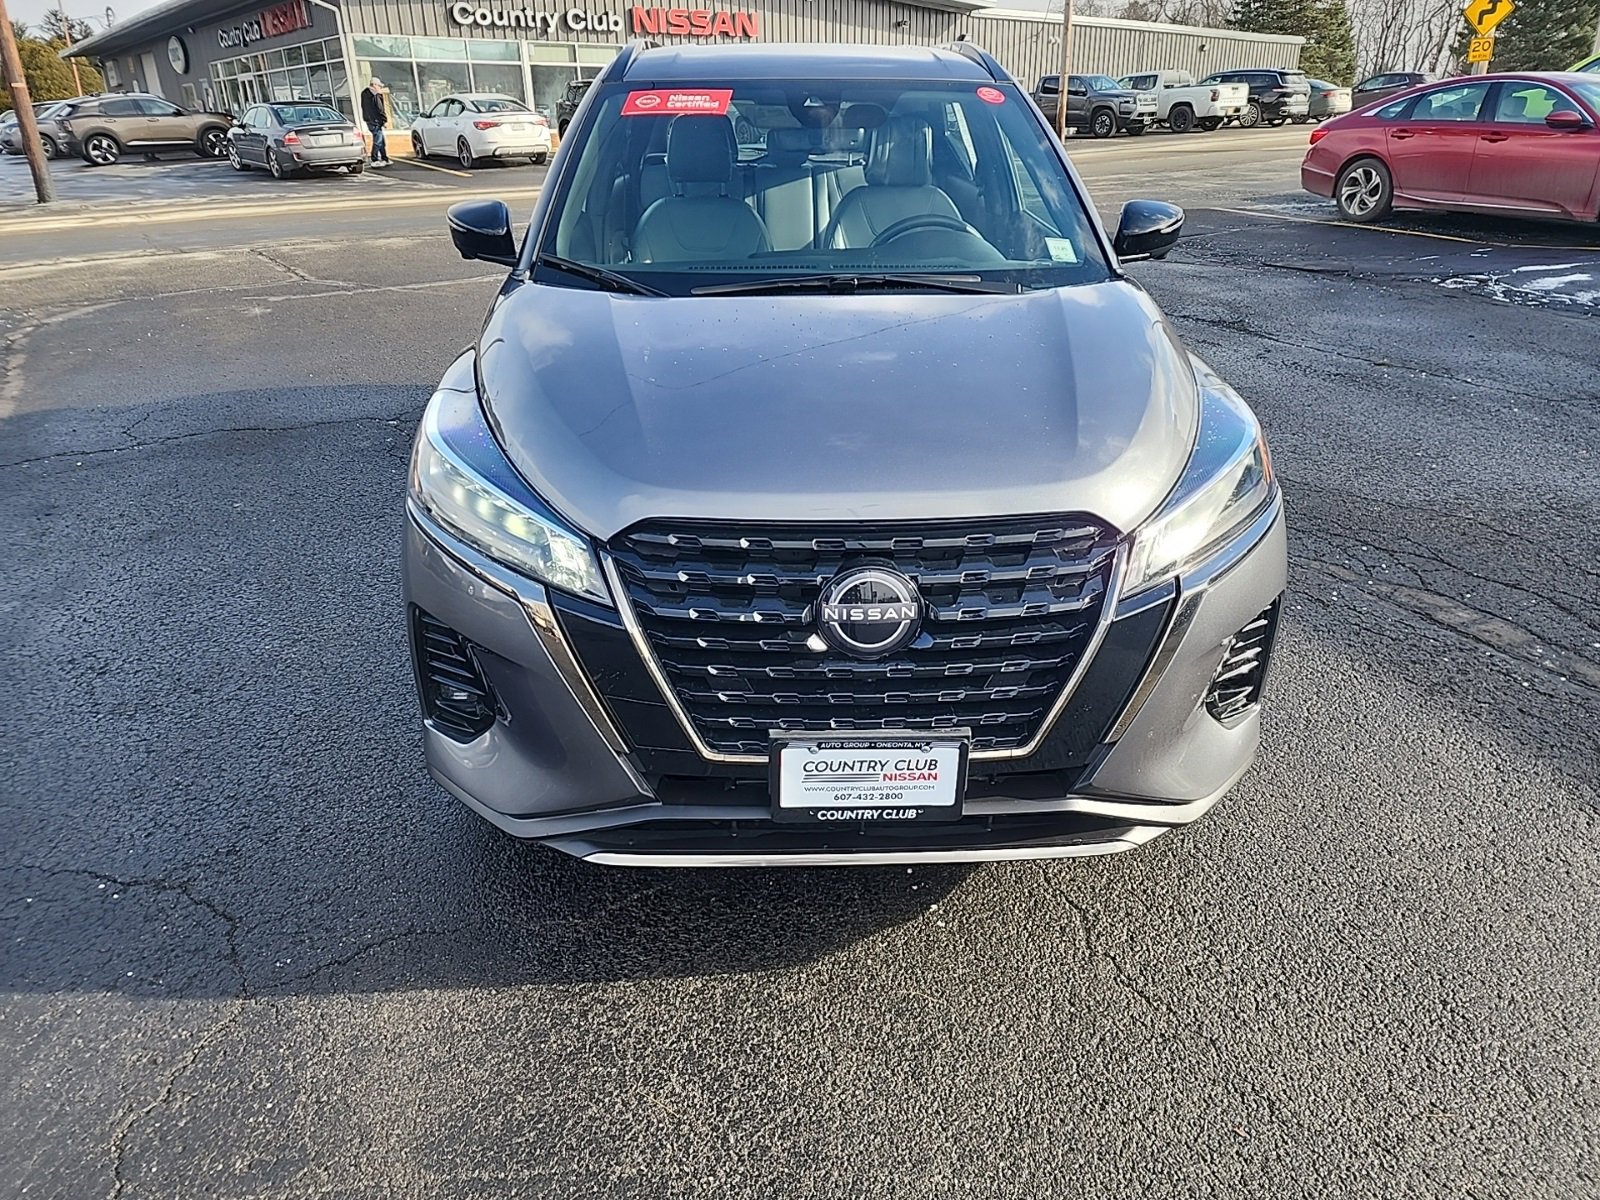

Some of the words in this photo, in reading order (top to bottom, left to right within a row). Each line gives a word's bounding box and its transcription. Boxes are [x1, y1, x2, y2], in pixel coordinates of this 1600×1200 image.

[452, 1, 559, 33] Country
[566, 8, 623, 32] Club
[632, 5, 760, 38] NISSAN
[1472, 40, 1491, 53] 20
[668, 94, 710, 102] Nissan
[666, 101, 720, 109] Certified
[824, 605, 915, 621] NISSAN
[803, 760, 890, 773] COUNTRY
[894, 759, 939, 771] CLUB
[882, 772, 938, 782] NISSAN
[833, 793, 904, 801] 607-432-2800
[817, 809, 880, 820] COUNTRY
[882, 809, 917, 819] CLUB
